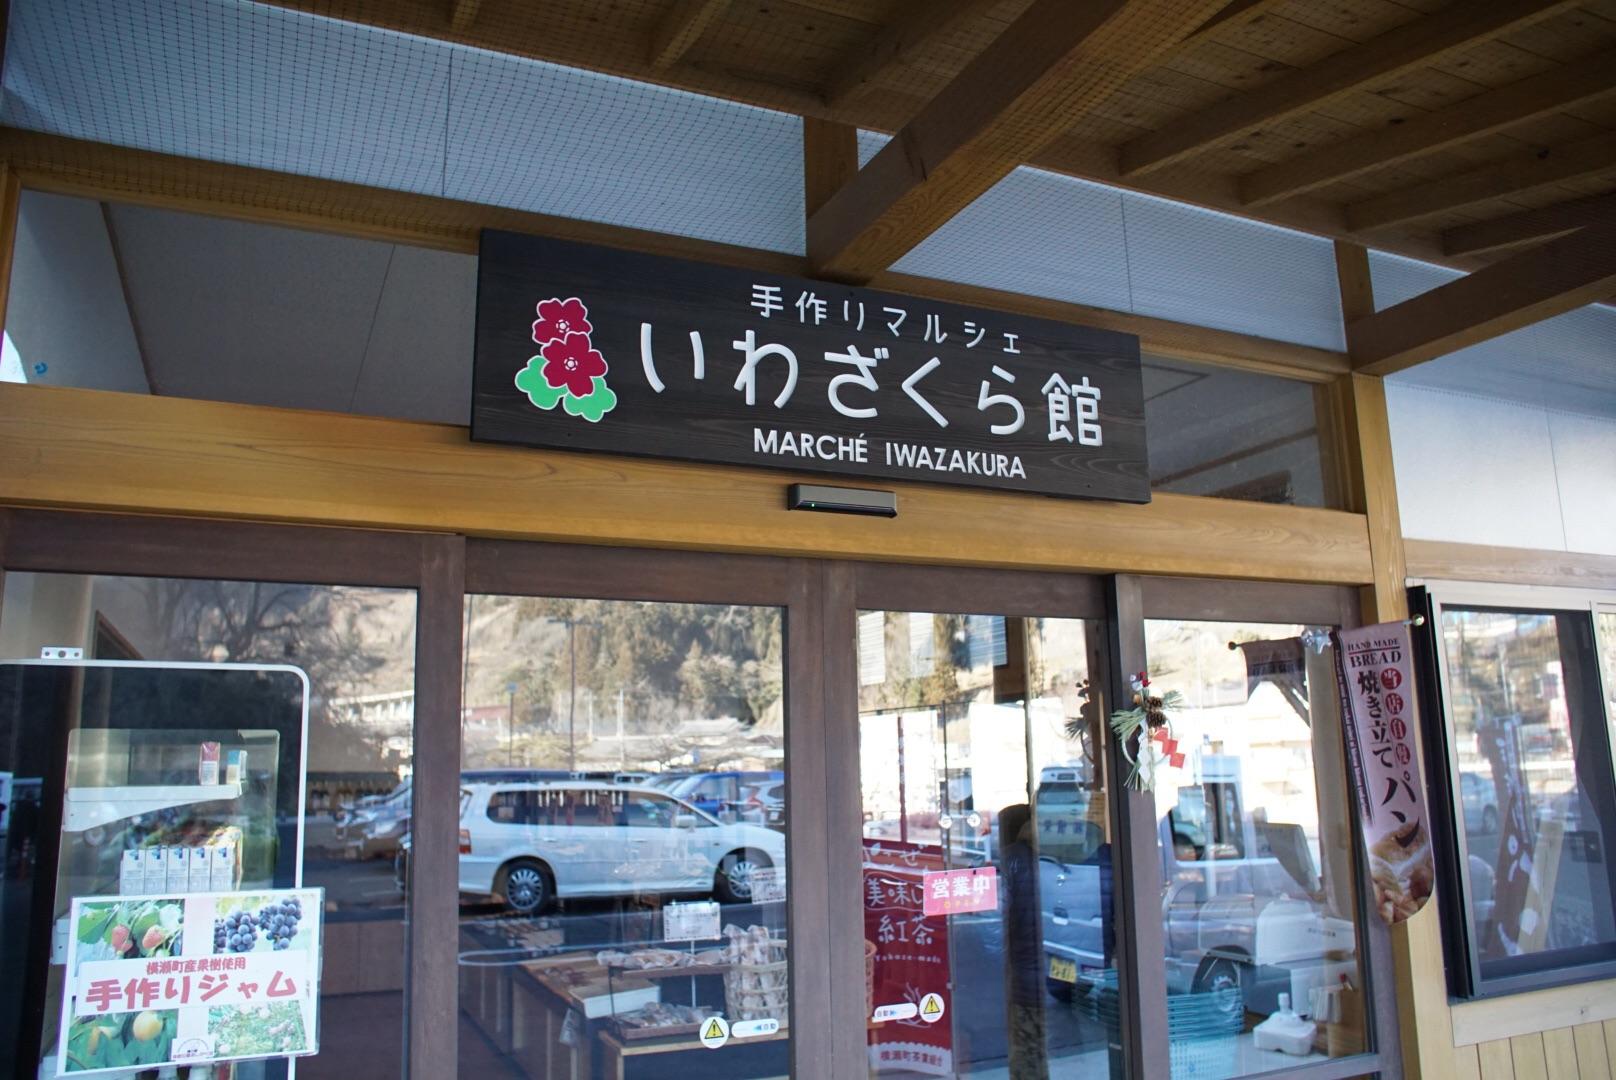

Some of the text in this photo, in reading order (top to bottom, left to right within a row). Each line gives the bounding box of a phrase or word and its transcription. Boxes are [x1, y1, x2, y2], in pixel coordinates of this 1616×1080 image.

[640, 322, 1102, 447] いわざくら館
[753, 427, 1027, 479] MARCHÉ IWAZAKURA
[1347, 638, 1400, 652] HAND MADE
[1350, 650, 1402, 668] BREAD
[867, 878, 923, 906] 美味し
[931, 874, 990, 899] 営業中
[878, 914, 935, 945] 紅茶
[85, 969, 297, 1012] 手作りジャム
